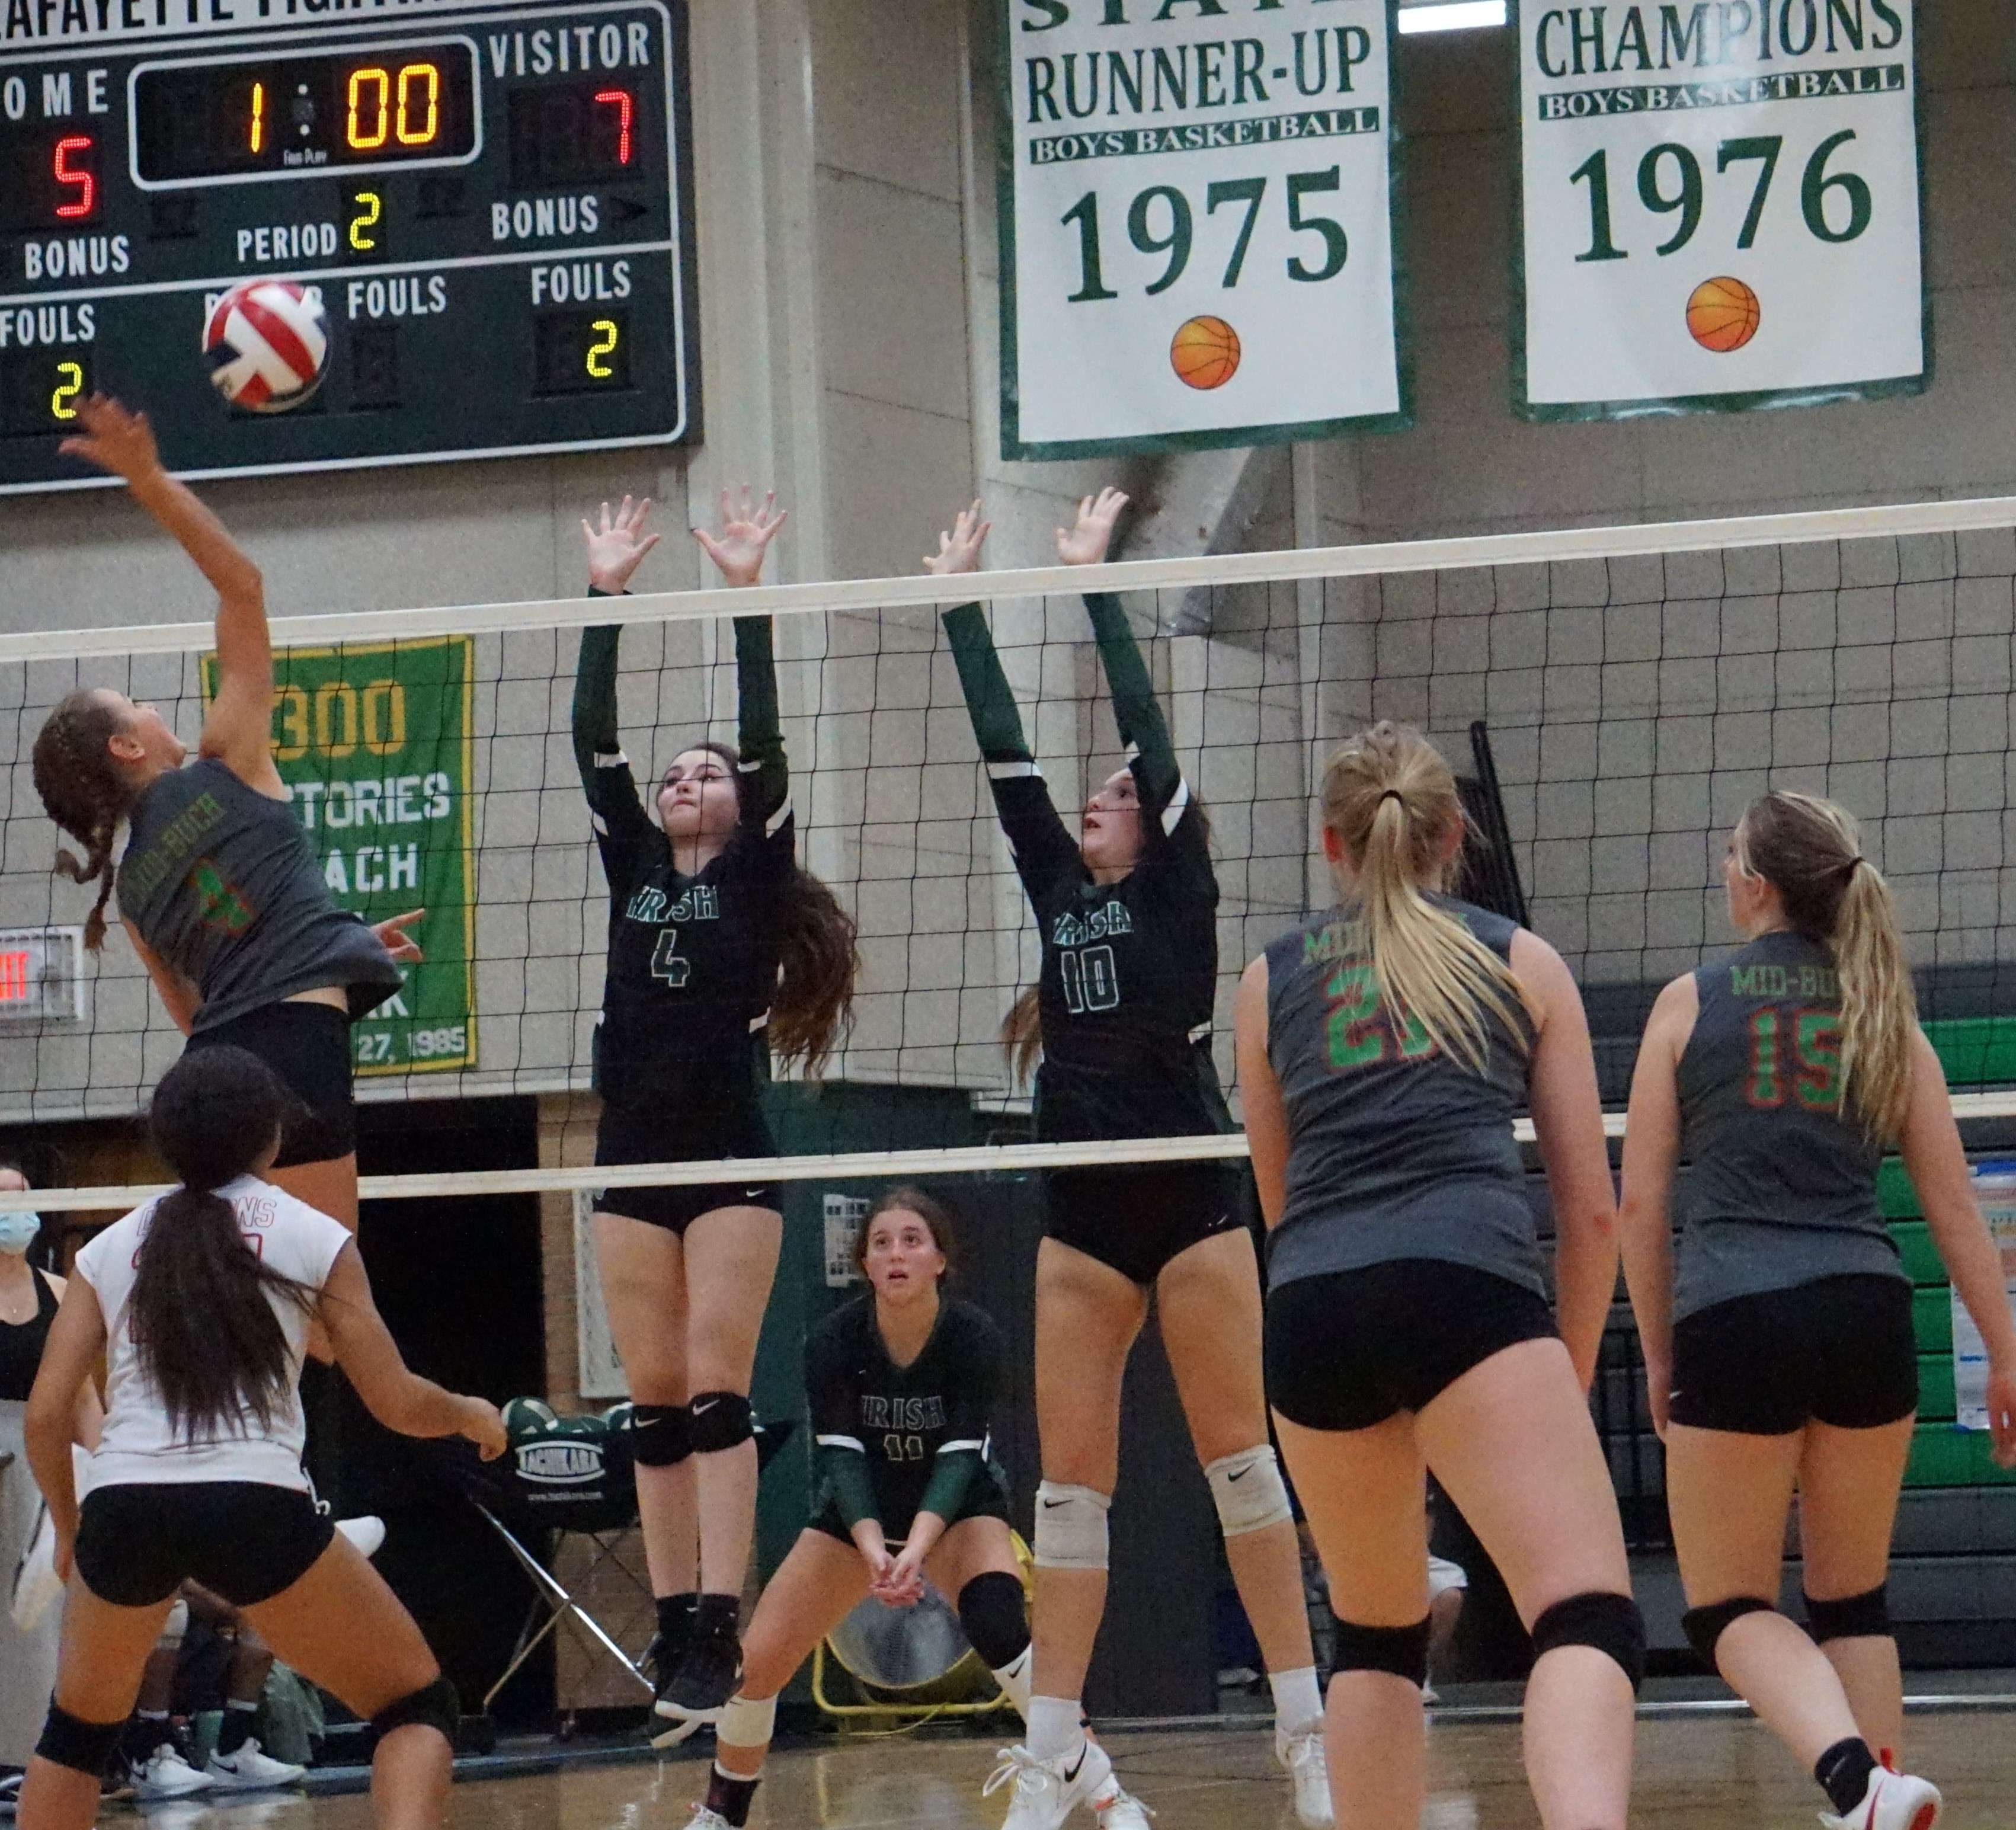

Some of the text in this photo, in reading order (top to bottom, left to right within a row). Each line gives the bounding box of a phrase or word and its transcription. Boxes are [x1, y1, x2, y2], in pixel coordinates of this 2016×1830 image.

[489, 22, 649, 78] VISITOR
[1536, 0, 1903, 78] CHAMPIONS
[1026, 26, 1371, 123] RUNNER-UP
[1545, 66, 1902, 118] BOYS BASKETBALL
[595, 92, 631, 164] 7
[1036, 109, 1378, 163] BOYS BASKETBALL
[55, 137, 93, 216] 5
[1570, 129, 1871, 263] 1976
[238, 193, 380, 261] PERIOD 2
[492, 195, 599, 241] BONUS
[1061, 165, 1348, 303] 1975
[25, 236, 130, 279] BONUS
[532, 261, 632, 304] FOULS
[0, 303, 96, 347] FOULS
[348, 276, 446, 319] FOULS
[587, 320, 617, 377] 2
[52, 362, 82, 420] 2
[270, 679, 405, 760] 300
[287, 772, 450, 829] TORIES
[626, 885, 720, 923] IRSH
[651, 929, 690, 987] 4
[1061, 945, 1119, 1014] 10
[407, 1026, 465, 1057] 1985
[1745, 1005, 1841, 1112] 15
[861, 1395, 946, 1430] IRISH
[884, 1434, 923, 1461] 11
